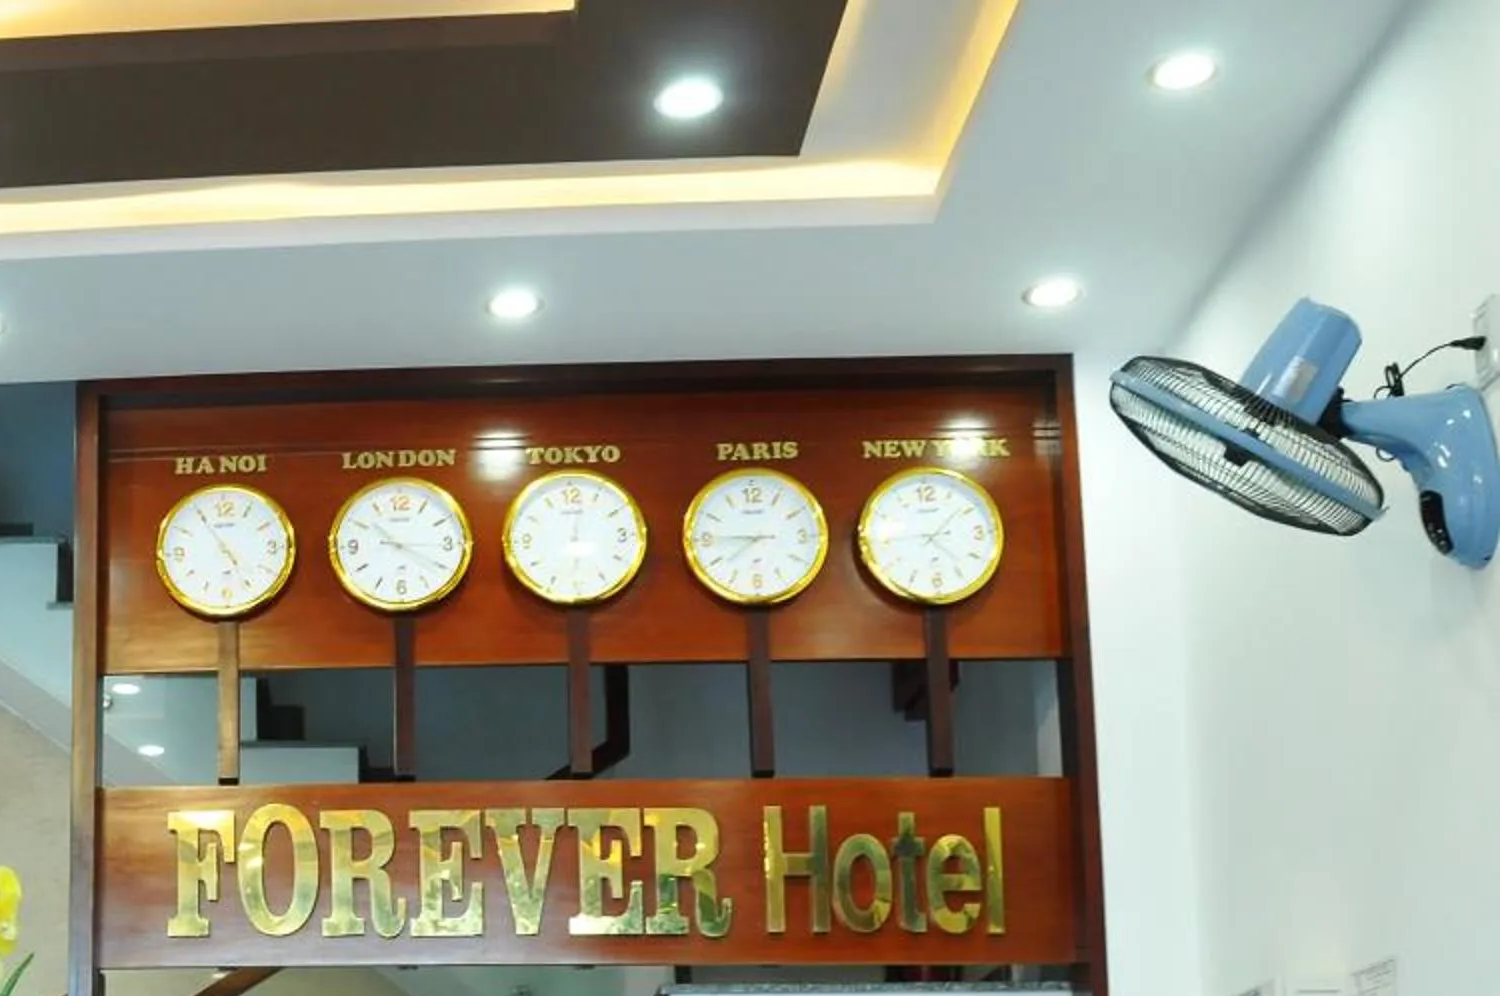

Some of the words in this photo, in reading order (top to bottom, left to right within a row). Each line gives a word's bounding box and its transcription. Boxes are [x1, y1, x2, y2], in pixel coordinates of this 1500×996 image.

[526, 445, 621, 465] TOKYO
[716, 441, 799, 461] PARIS
[862, 439, 927, 459] NEW
[932, 437, 1011, 457] YK
[341, 448, 457, 469] LONDON
[562, 487, 581, 504] 12
[741, 487, 762, 504] 12
[916, 485, 936, 504] 12
[390, 495, 410, 512] 12
[443, 536, 453, 552] 3
[797, 529, 808, 544] 3
[348, 539, 359, 555] 9
[396, 579, 407, 595] 6
[752, 573, 764, 589] 6
[167, 803, 733, 939] FOREVER
[763, 804, 1006, 935] Hotel
